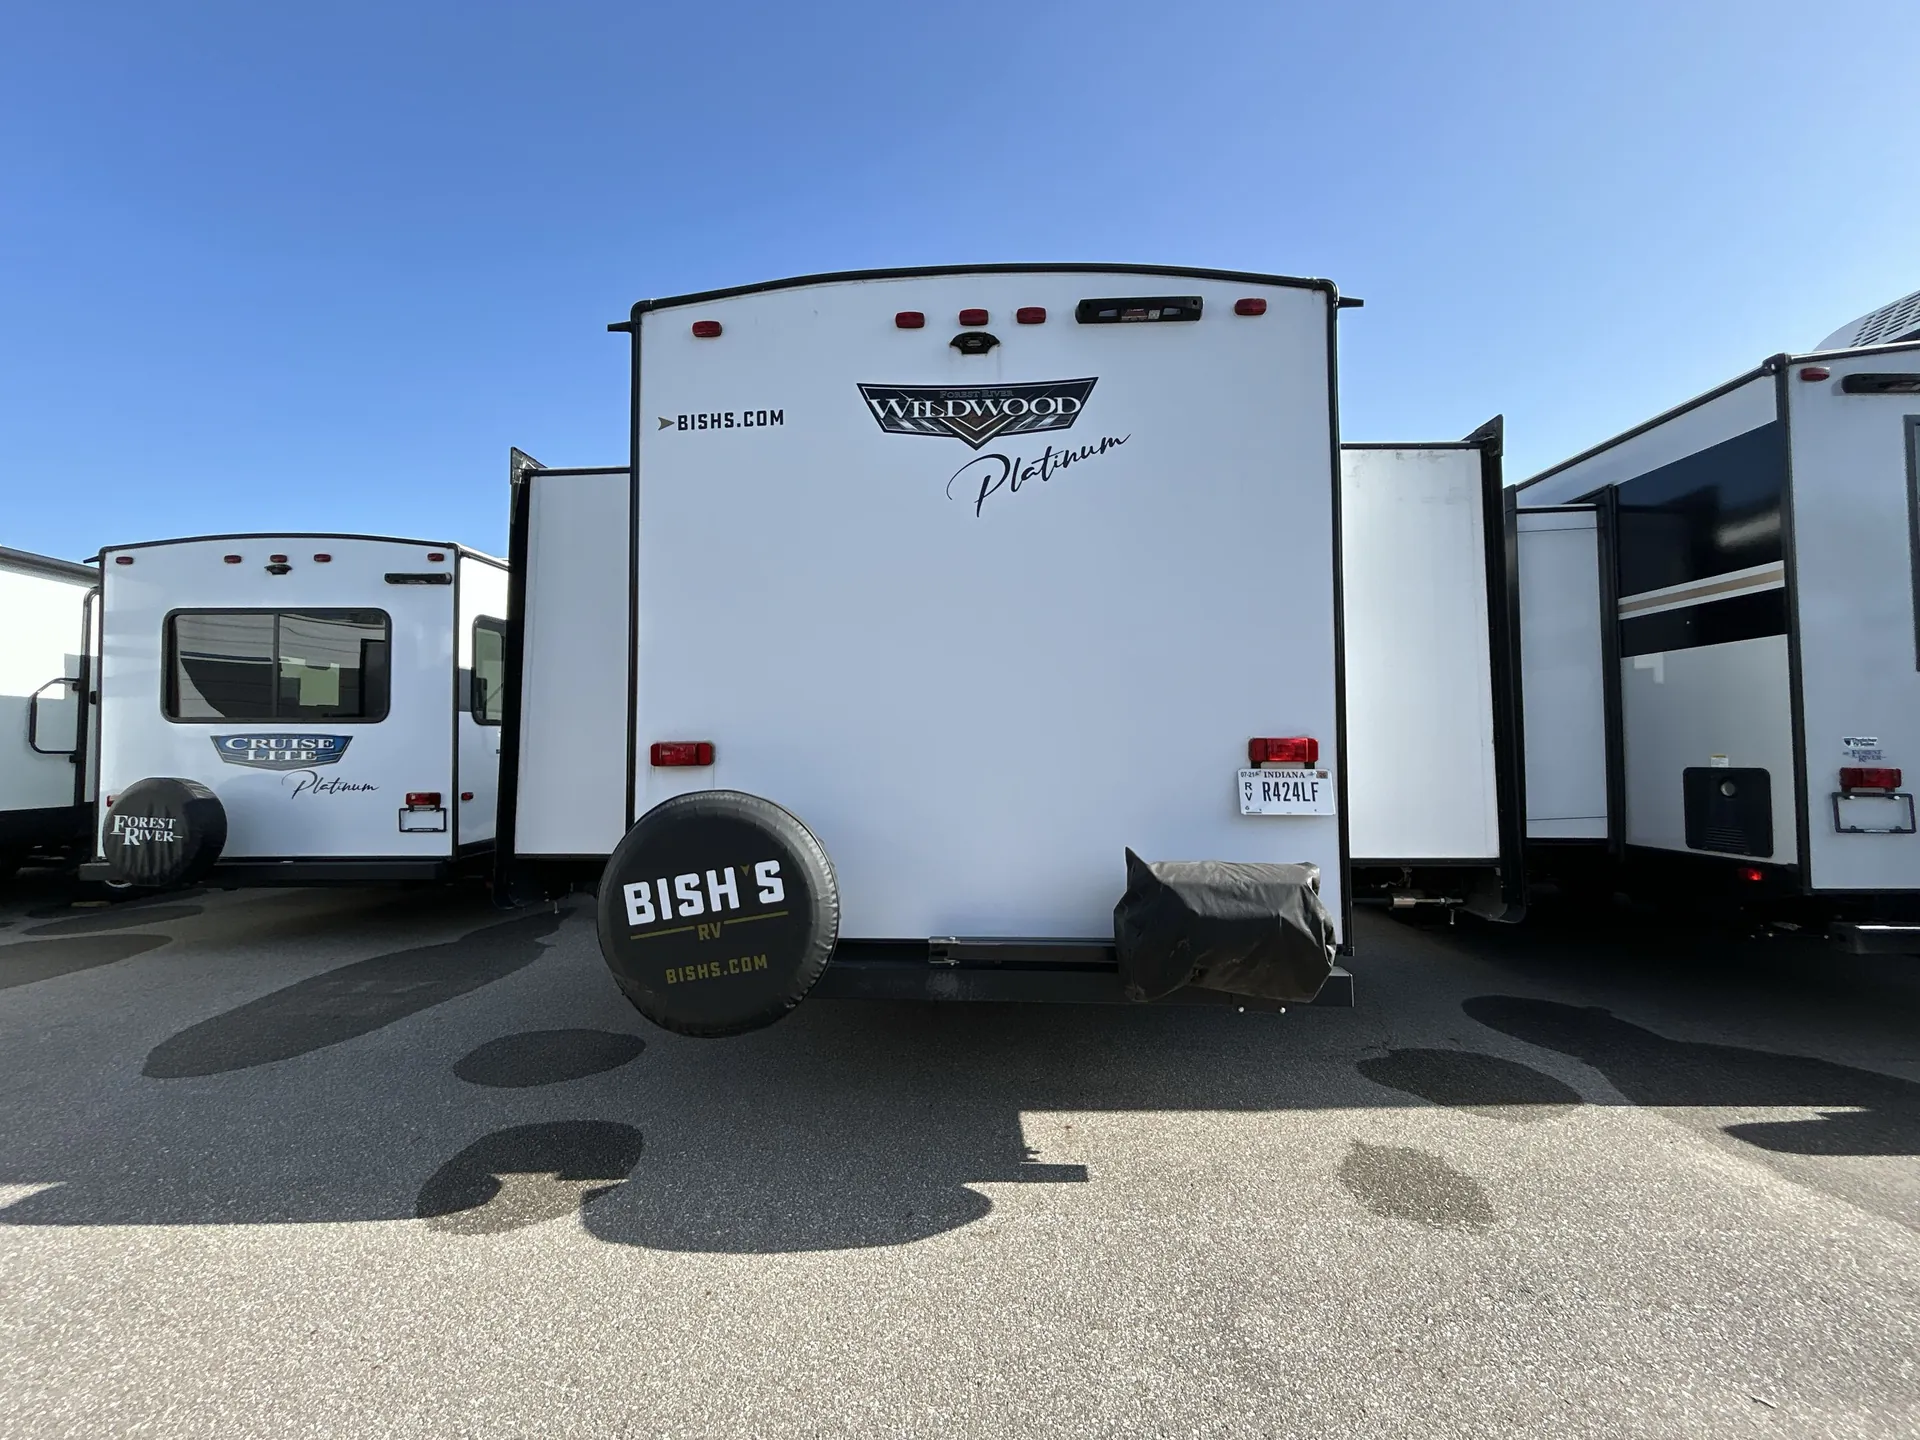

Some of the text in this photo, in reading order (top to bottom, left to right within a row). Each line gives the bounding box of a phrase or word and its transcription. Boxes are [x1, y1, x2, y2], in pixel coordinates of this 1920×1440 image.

[940, 389, 1014, 399] FOREST RIVER
[868, 396, 1083, 419] WILDWOOD
[678, 409, 784, 431] BISHS.COM
[946, 434, 1131, 518] Platinum
[225, 737, 335, 750] CRUISE
[247, 749, 318, 761] LITE
[281, 769, 380, 800] Platinum
[1264, 771, 1305, 779] INDIANA
[1262, 781, 1319, 802] R424LF
[112, 814, 176, 833] FOREST
[122, 827, 174, 846] RIVER
[697, 921, 723, 941] RV
[665, 954, 768, 985] BISHS.COM
